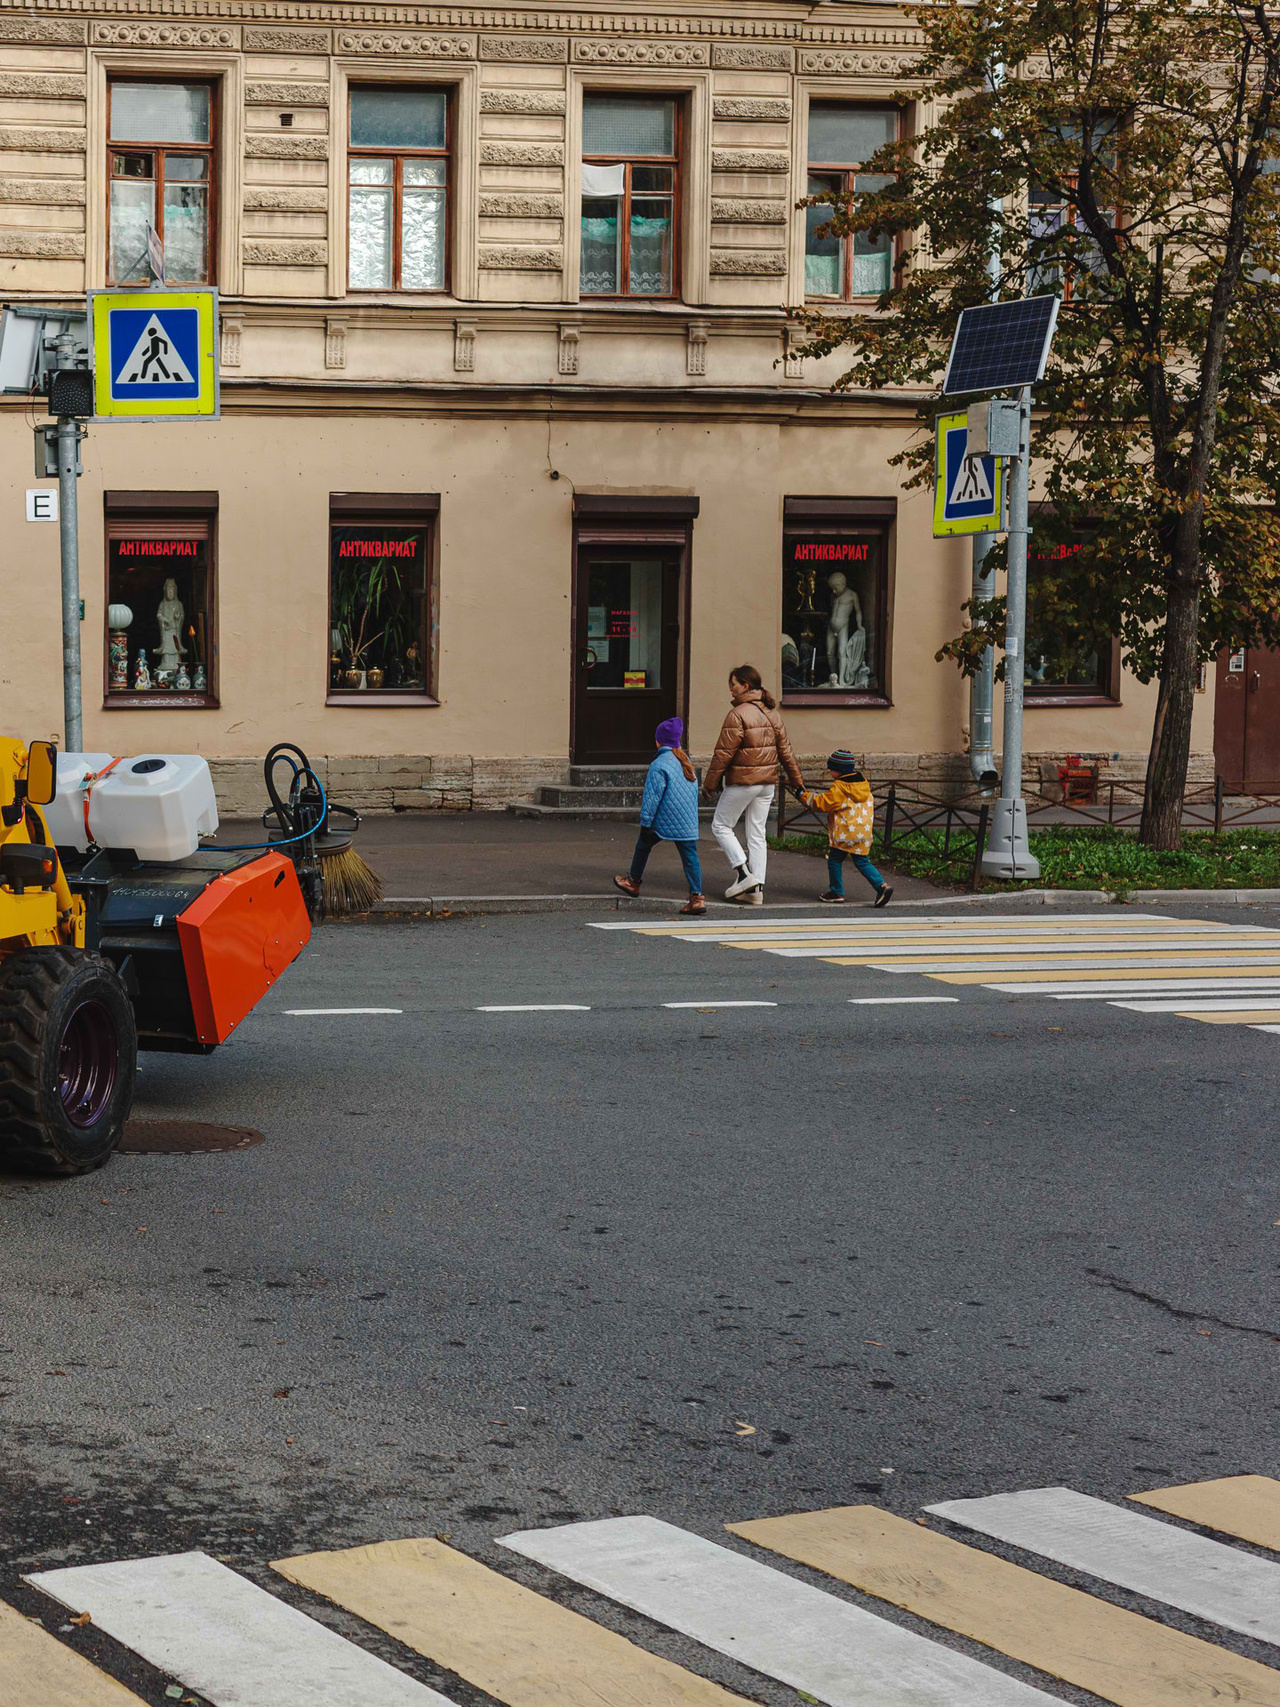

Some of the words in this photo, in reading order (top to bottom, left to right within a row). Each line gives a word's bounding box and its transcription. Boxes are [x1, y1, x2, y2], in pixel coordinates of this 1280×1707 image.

[118, 541, 199, 556] АНТИКВАРИАТ
[339, 540, 418, 557] АНТИКВАРИАТ
[794, 544, 869, 560] АНТИКВАРИАТ
